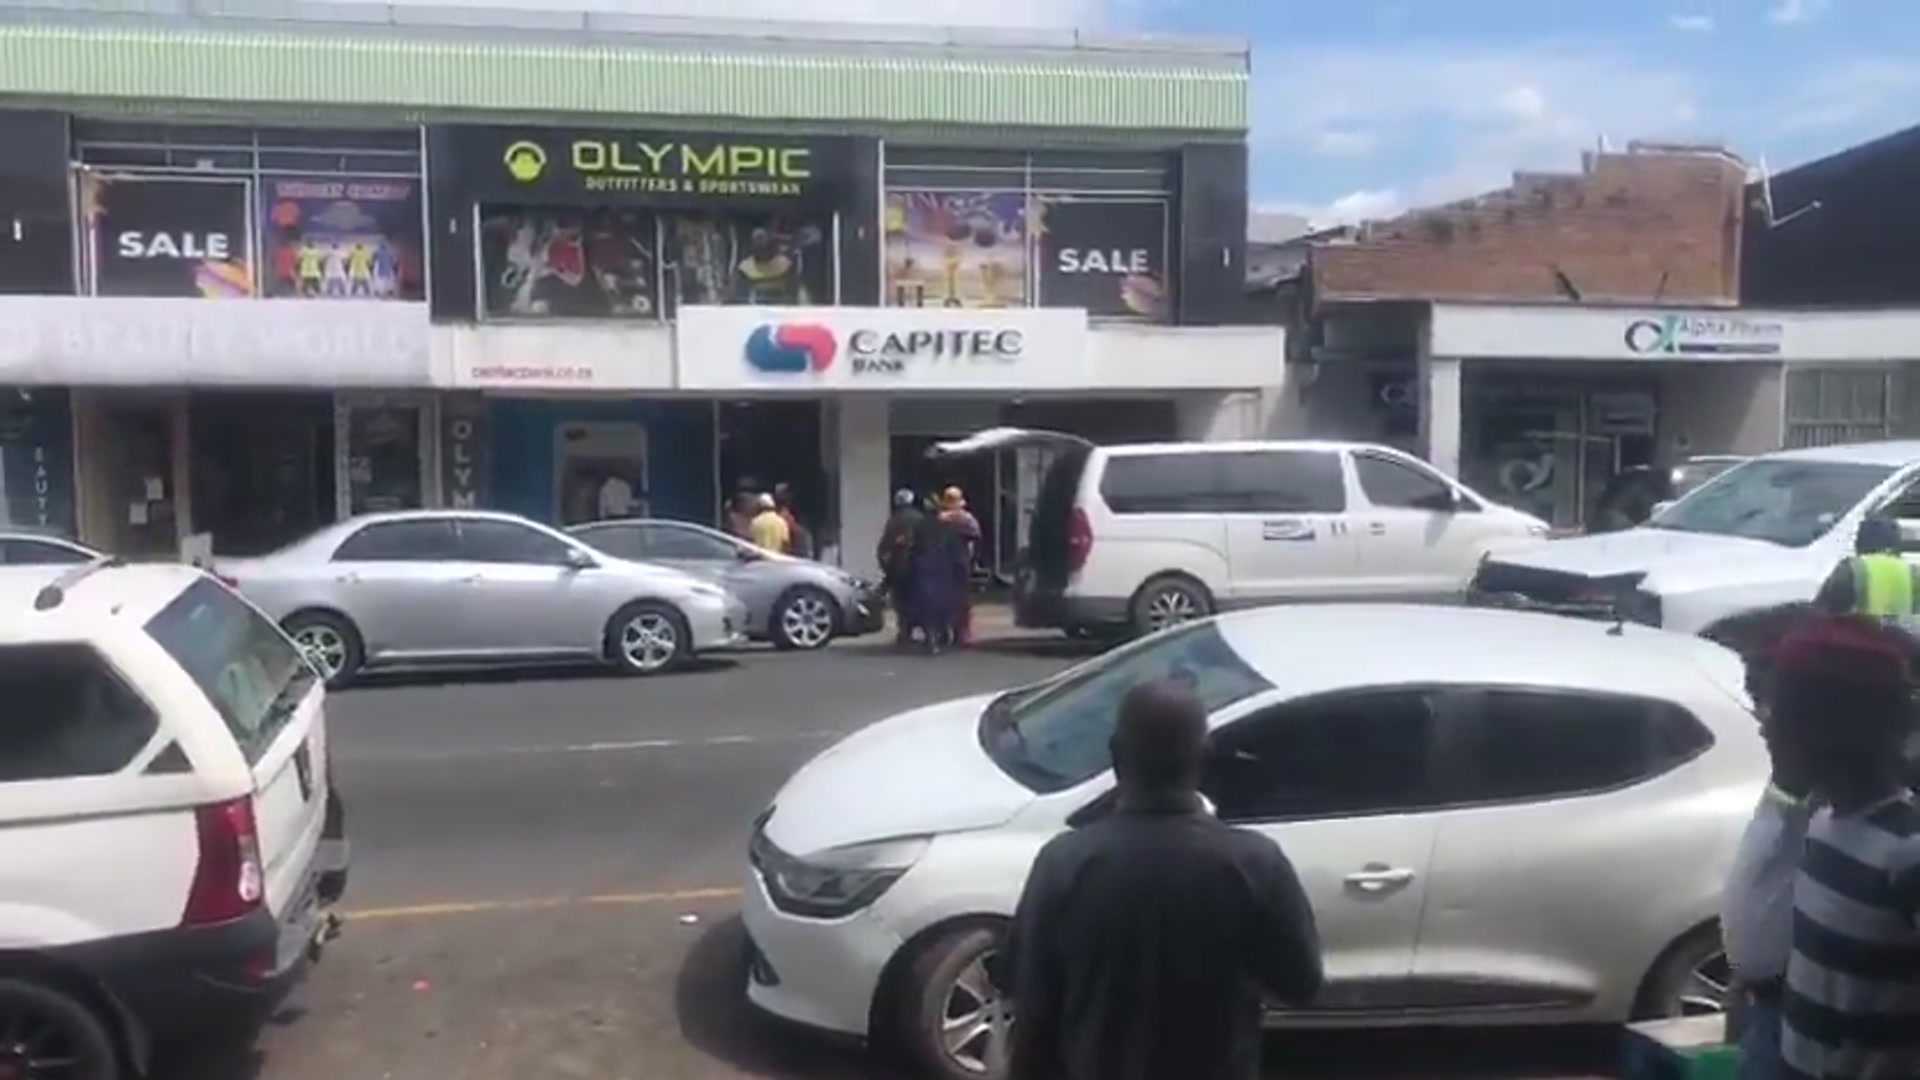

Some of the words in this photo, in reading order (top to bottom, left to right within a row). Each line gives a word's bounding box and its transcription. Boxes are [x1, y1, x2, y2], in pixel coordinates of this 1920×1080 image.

[571, 140, 811, 178] OLYMPIC
[586, 176, 678, 192] OUTFITTERS
[683, 181, 694, 192] &
[700, 179, 801, 195] SPORTSWEAR
[119, 231, 230, 258] SALE
[1059, 247, 1150, 273] SALE
[63, 319, 236, 358] BEAUTY
[255, 320, 413, 360] WORLD
[849, 329, 1024, 356] CAPITEC
[852, 357, 905, 374] BANK
